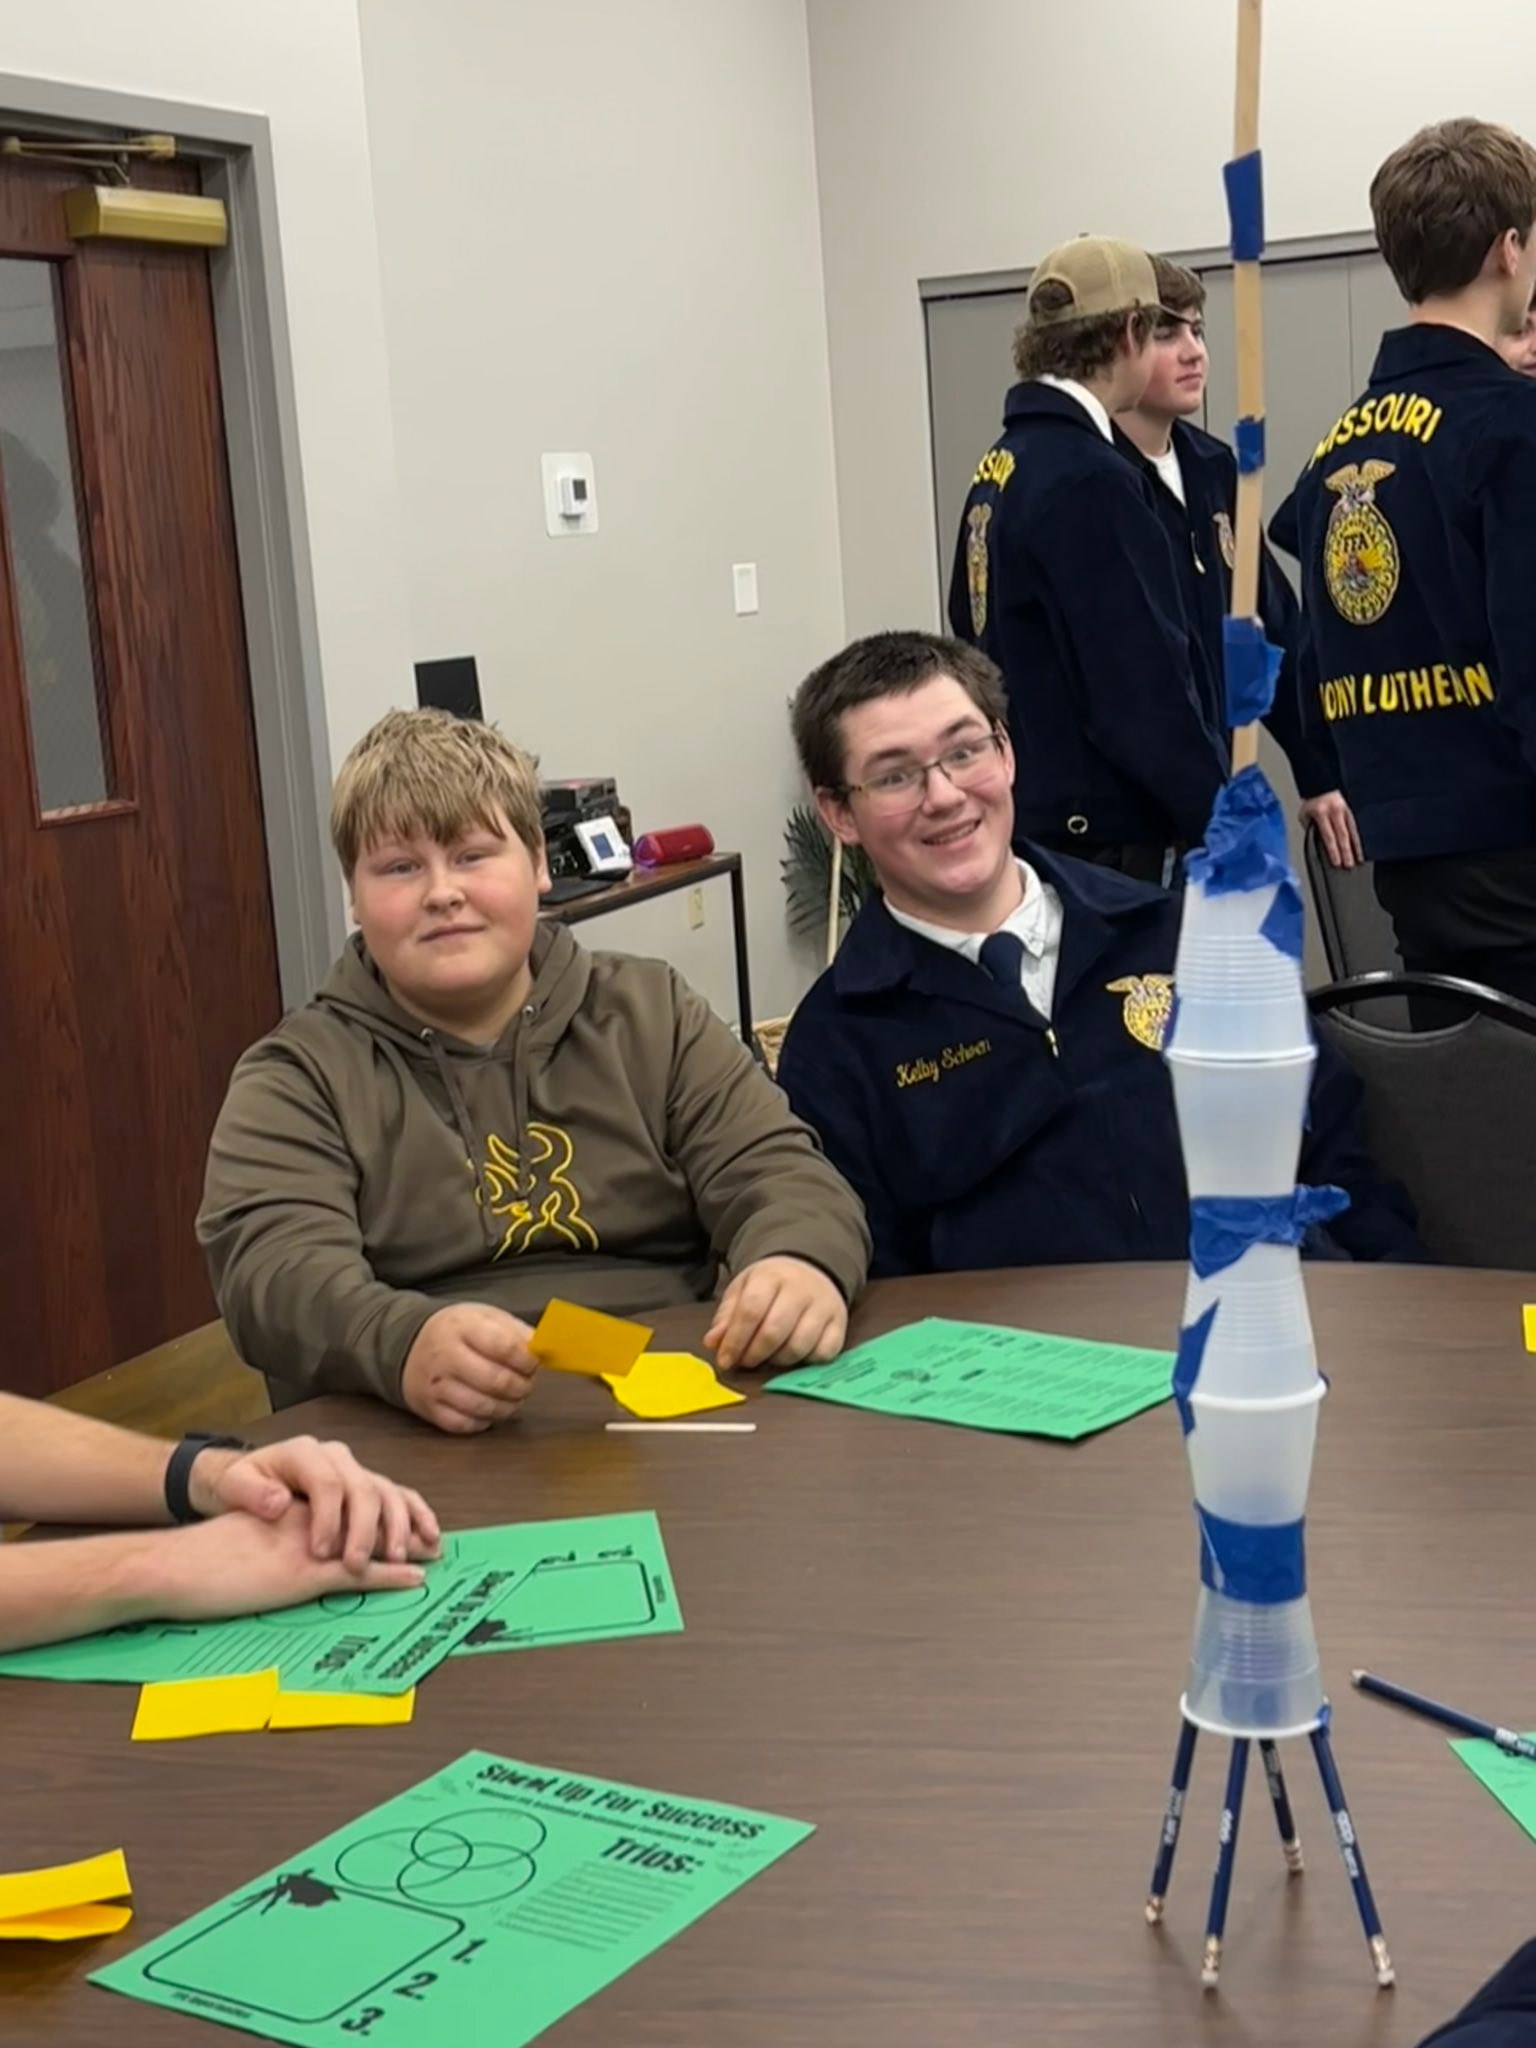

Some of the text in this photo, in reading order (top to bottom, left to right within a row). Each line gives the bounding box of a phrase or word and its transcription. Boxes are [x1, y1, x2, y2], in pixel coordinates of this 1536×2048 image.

[896, 1057, 940, 1088] Kelby
[553, 1780, 595, 1804] Up
[590, 1789, 645, 1813] For
[641, 1801, 767, 1839] Success
[601, 1836, 704, 1875] Trios:
[451, 1938, 487, 1965] 1.
[392, 1971, 439, 2001] 2.
[339, 2006, 385, 2037] 3.
